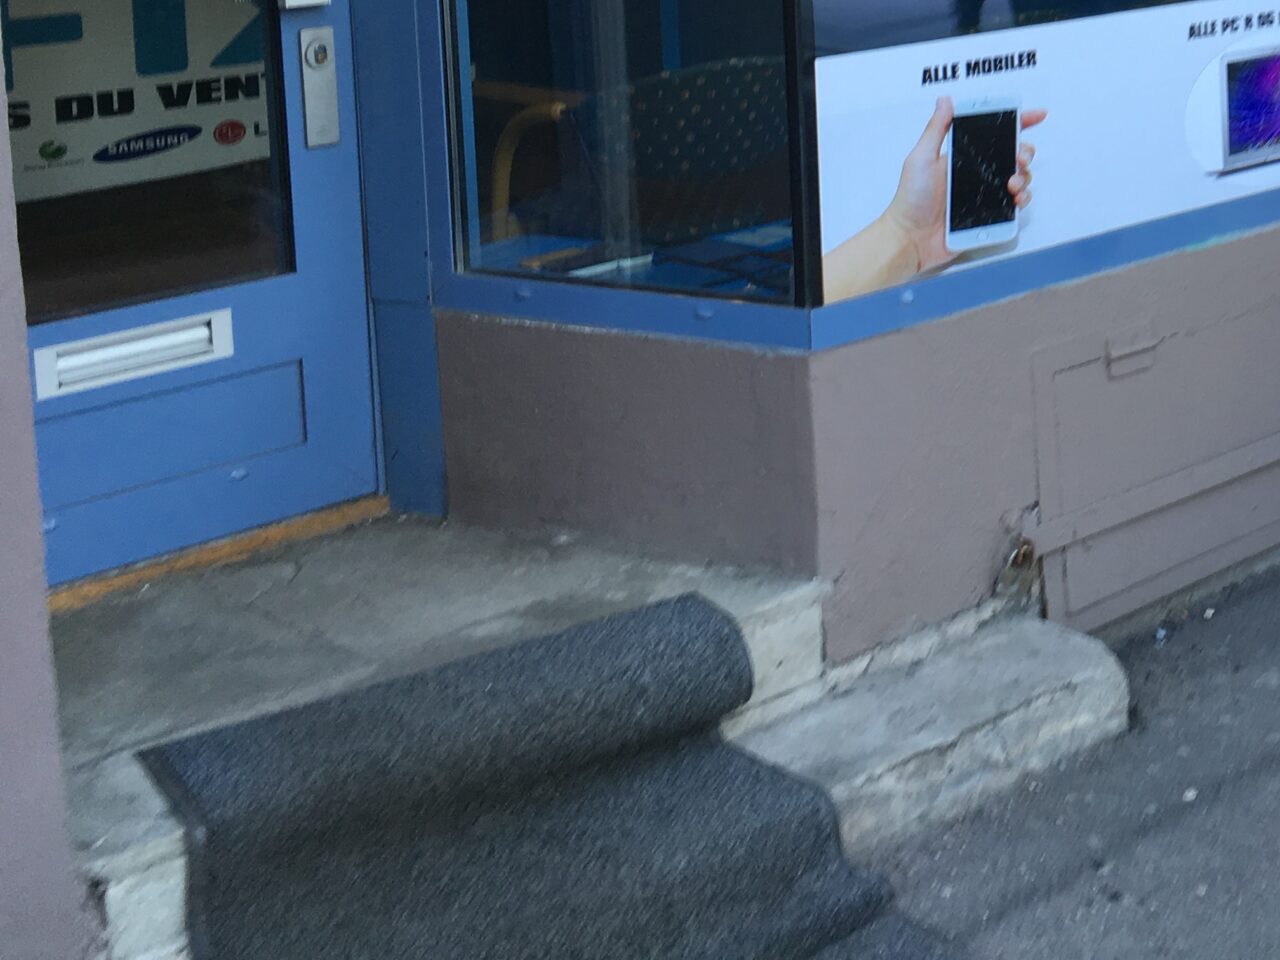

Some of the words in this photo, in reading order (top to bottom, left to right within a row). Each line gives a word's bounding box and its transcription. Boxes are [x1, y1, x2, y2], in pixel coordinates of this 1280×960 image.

[1187, 18, 1218, 41] ALLE
[921, 60, 960, 86] ALLE
[965, 48, 1038, 79] MOBILER
[54, 87, 135, 125] DU
[156, 72, 266, 111] VEN
[107, 131, 190, 157] SAMSUNG
